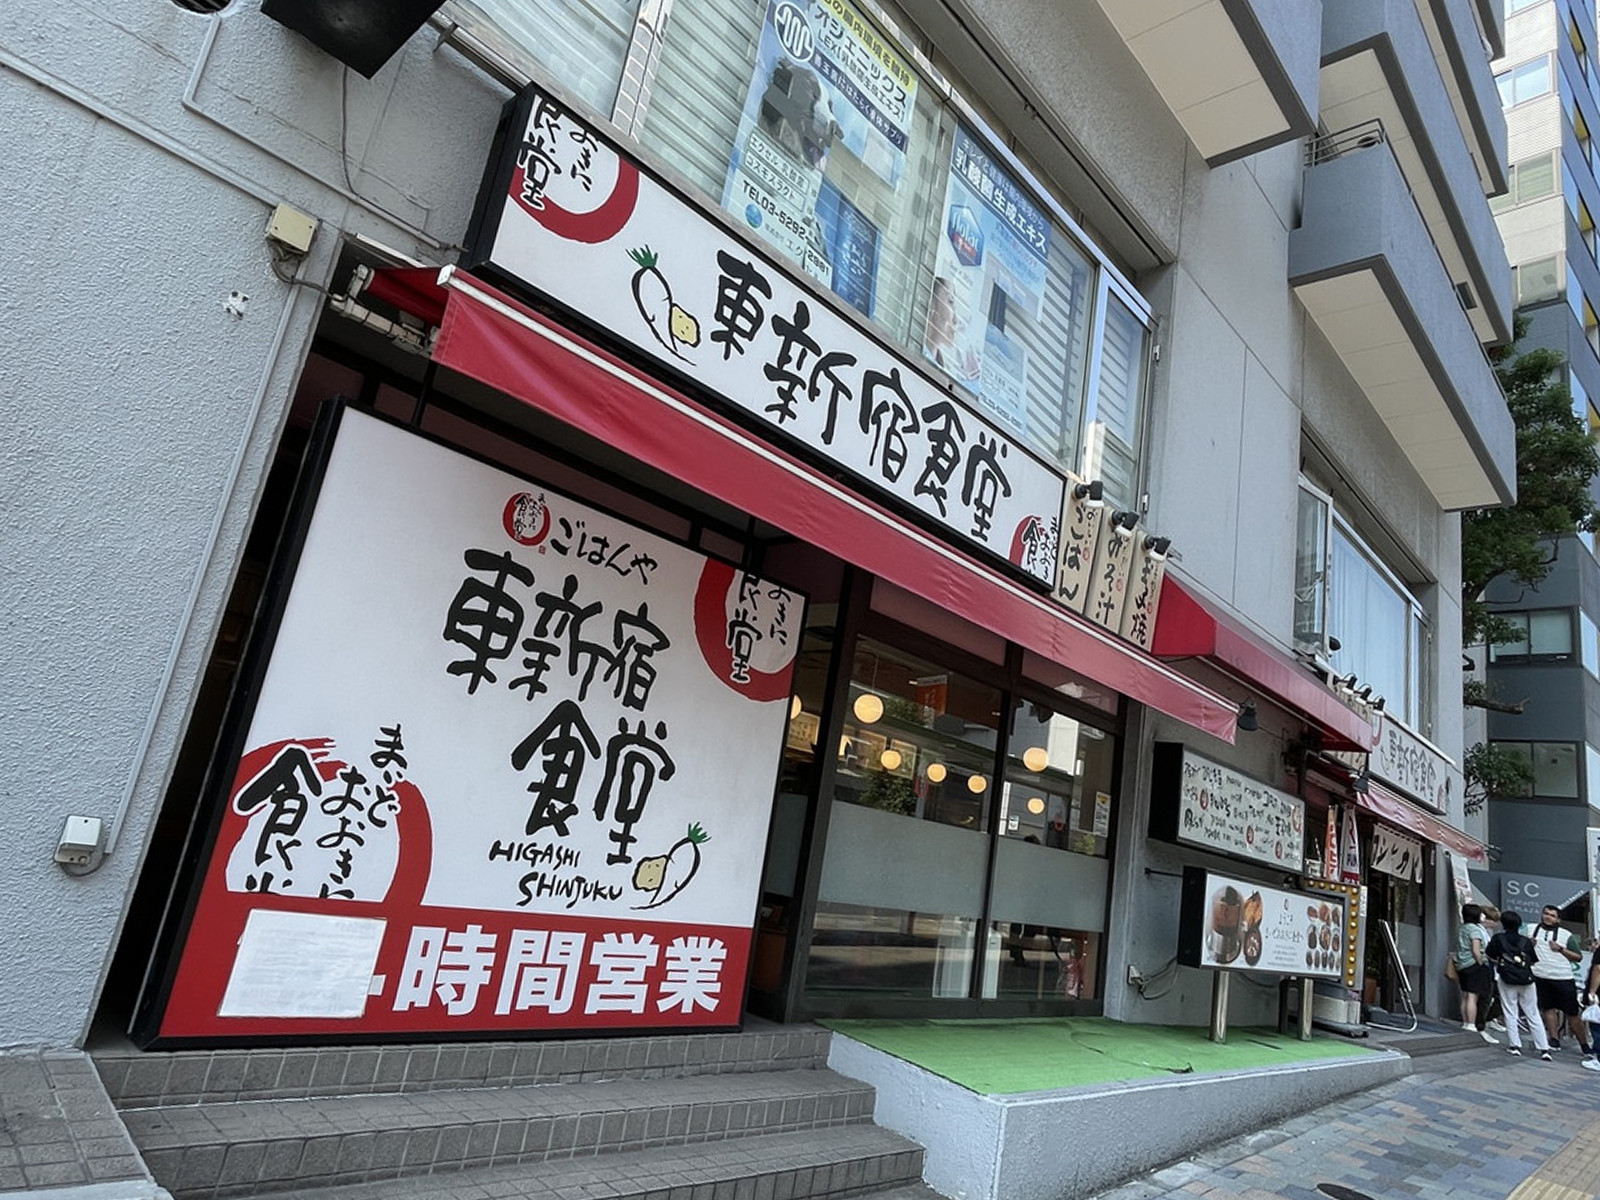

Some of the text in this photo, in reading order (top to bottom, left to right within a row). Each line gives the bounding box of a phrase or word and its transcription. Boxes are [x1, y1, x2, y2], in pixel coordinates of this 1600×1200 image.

[955, 147, 1047, 254] 乳酸菌生成エキス
[711, 249, 1012, 543] 東新宿食堂
[550, 516, 658, 585] ごはんや
[1058, 501, 1085, 602] ごはん
[443, 548, 671, 712] 東新宿
[237, 747, 323, 895] 食
[367, 723, 408, 828] まいど
[511, 699, 676, 866] 食堂
[488, 840, 582, 870] HIGASHI
[516, 871, 623, 909] SHINJUKU
[1506, 880, 1541, 898] SC
[367, 924, 728, 1017] 時間営業
